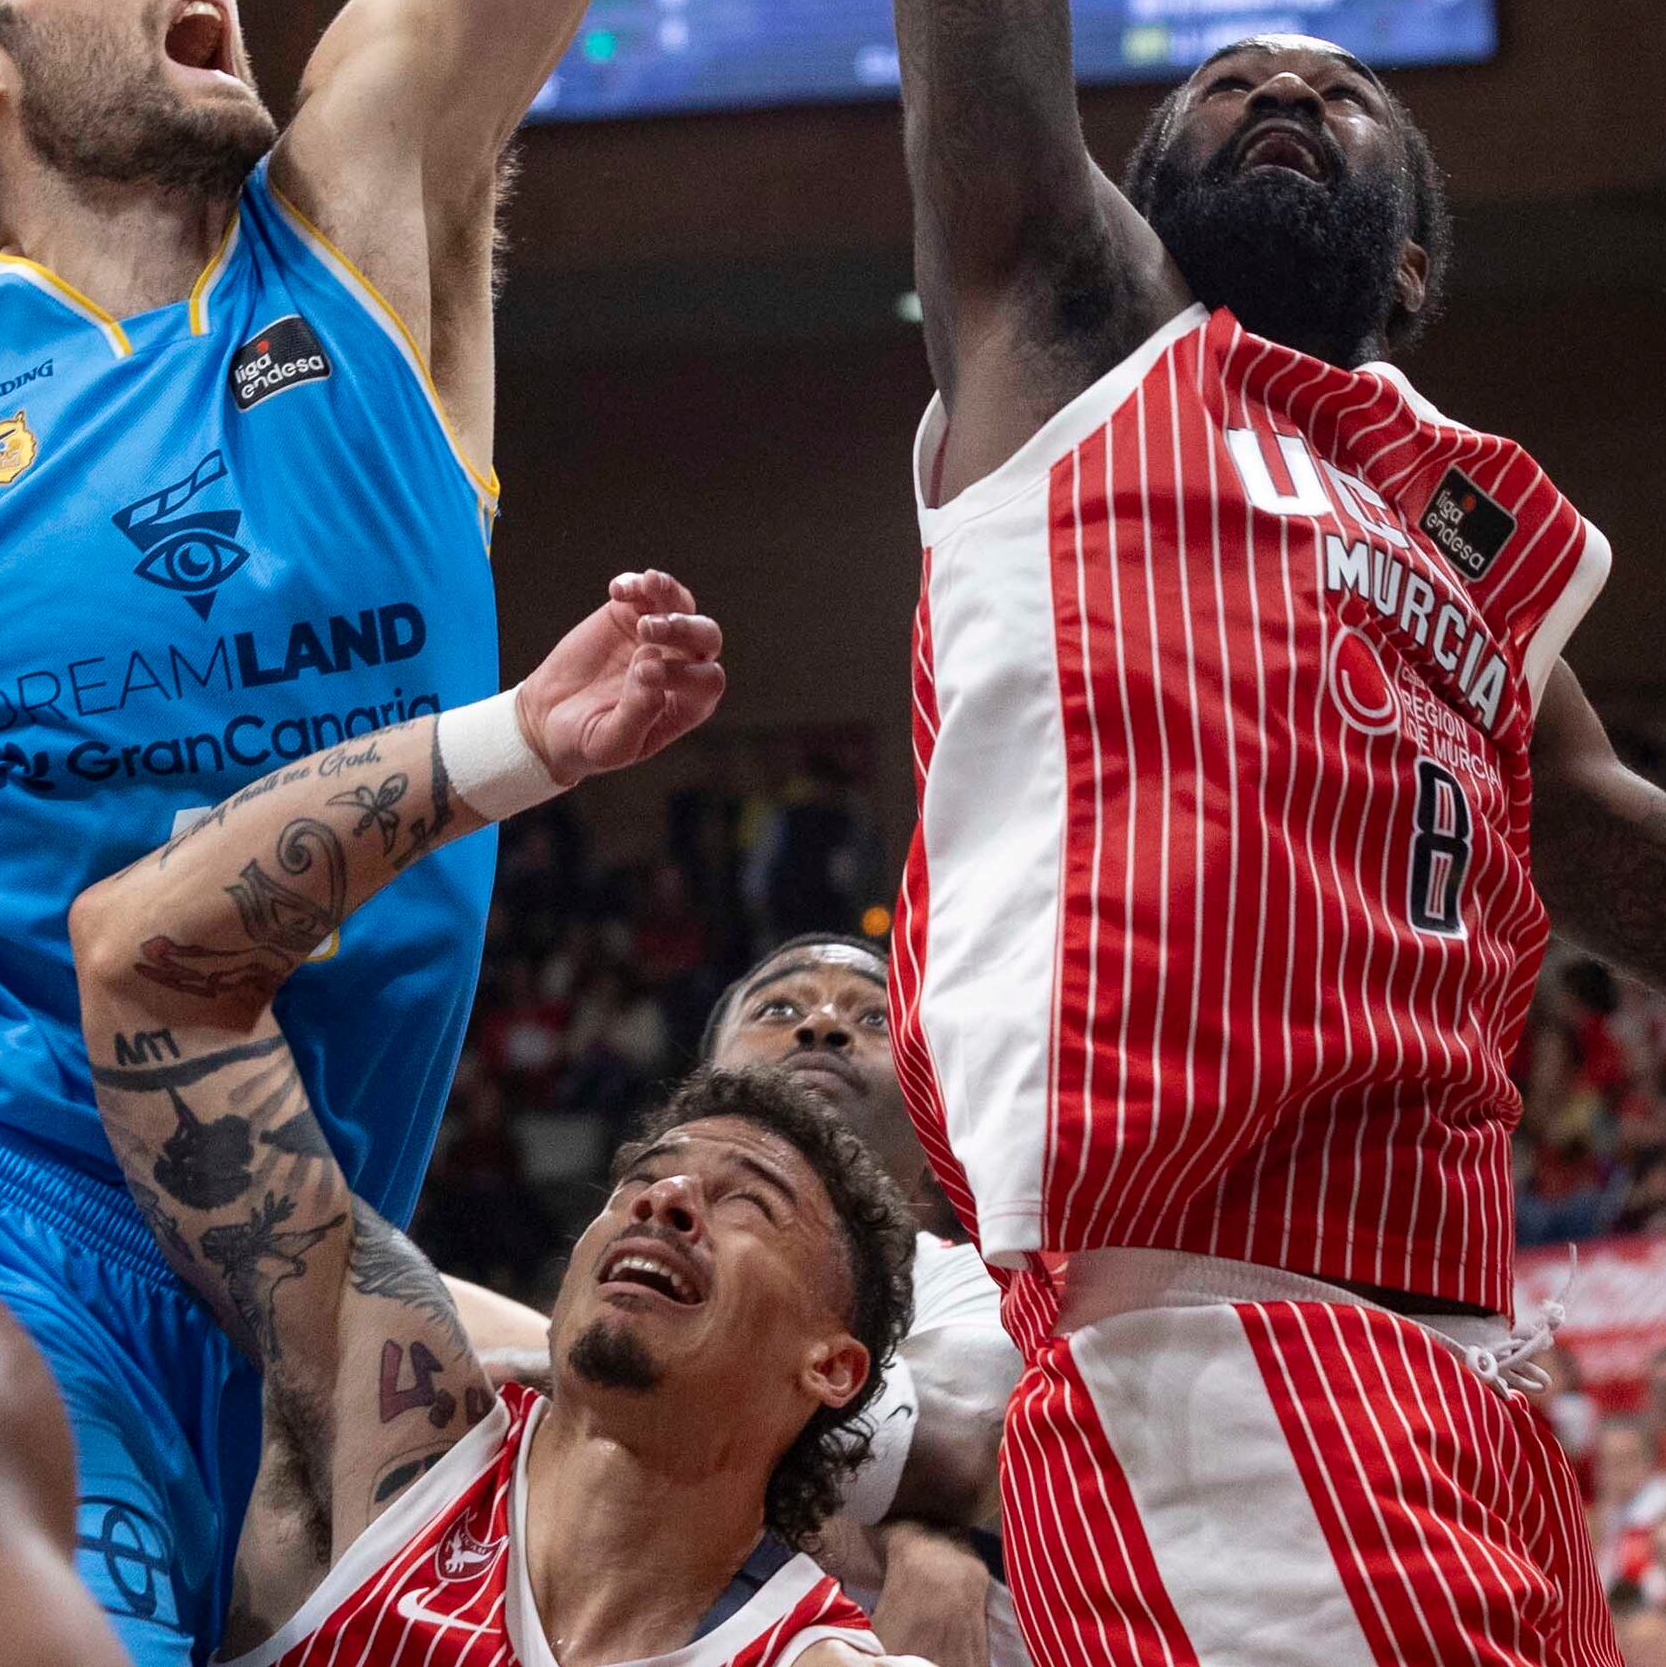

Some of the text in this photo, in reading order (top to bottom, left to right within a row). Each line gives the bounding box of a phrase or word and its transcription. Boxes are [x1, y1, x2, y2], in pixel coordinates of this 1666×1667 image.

[235, 354, 272, 385] liga
[241, 354, 326, 400] endesa
[1436, 489, 1464, 524] liga
[1425, 511, 1485, 571] endesa
[1324, 534, 1508, 732] MURCIA
[318, 740, 382, 777] God.
[1405, 718, 1501, 789] DE MURCIA
[1406, 755, 1470, 940] 8
